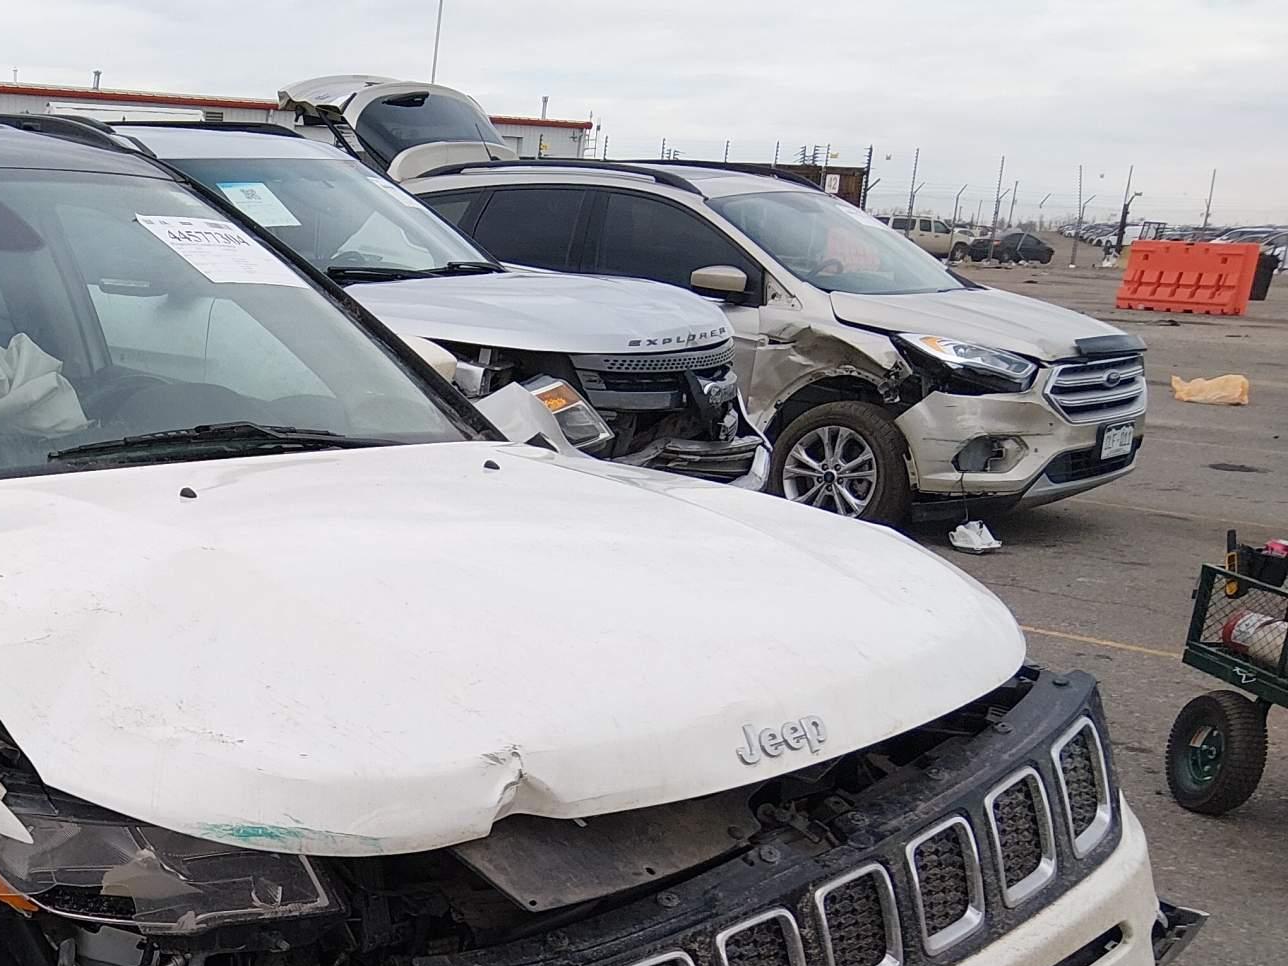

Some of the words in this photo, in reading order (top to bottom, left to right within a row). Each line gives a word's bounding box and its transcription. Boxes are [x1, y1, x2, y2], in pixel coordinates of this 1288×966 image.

[167, 229, 251, 247] 44577304
[628, 327, 727, 347] EXPLORER
[736, 715, 828, 766] Jeep
